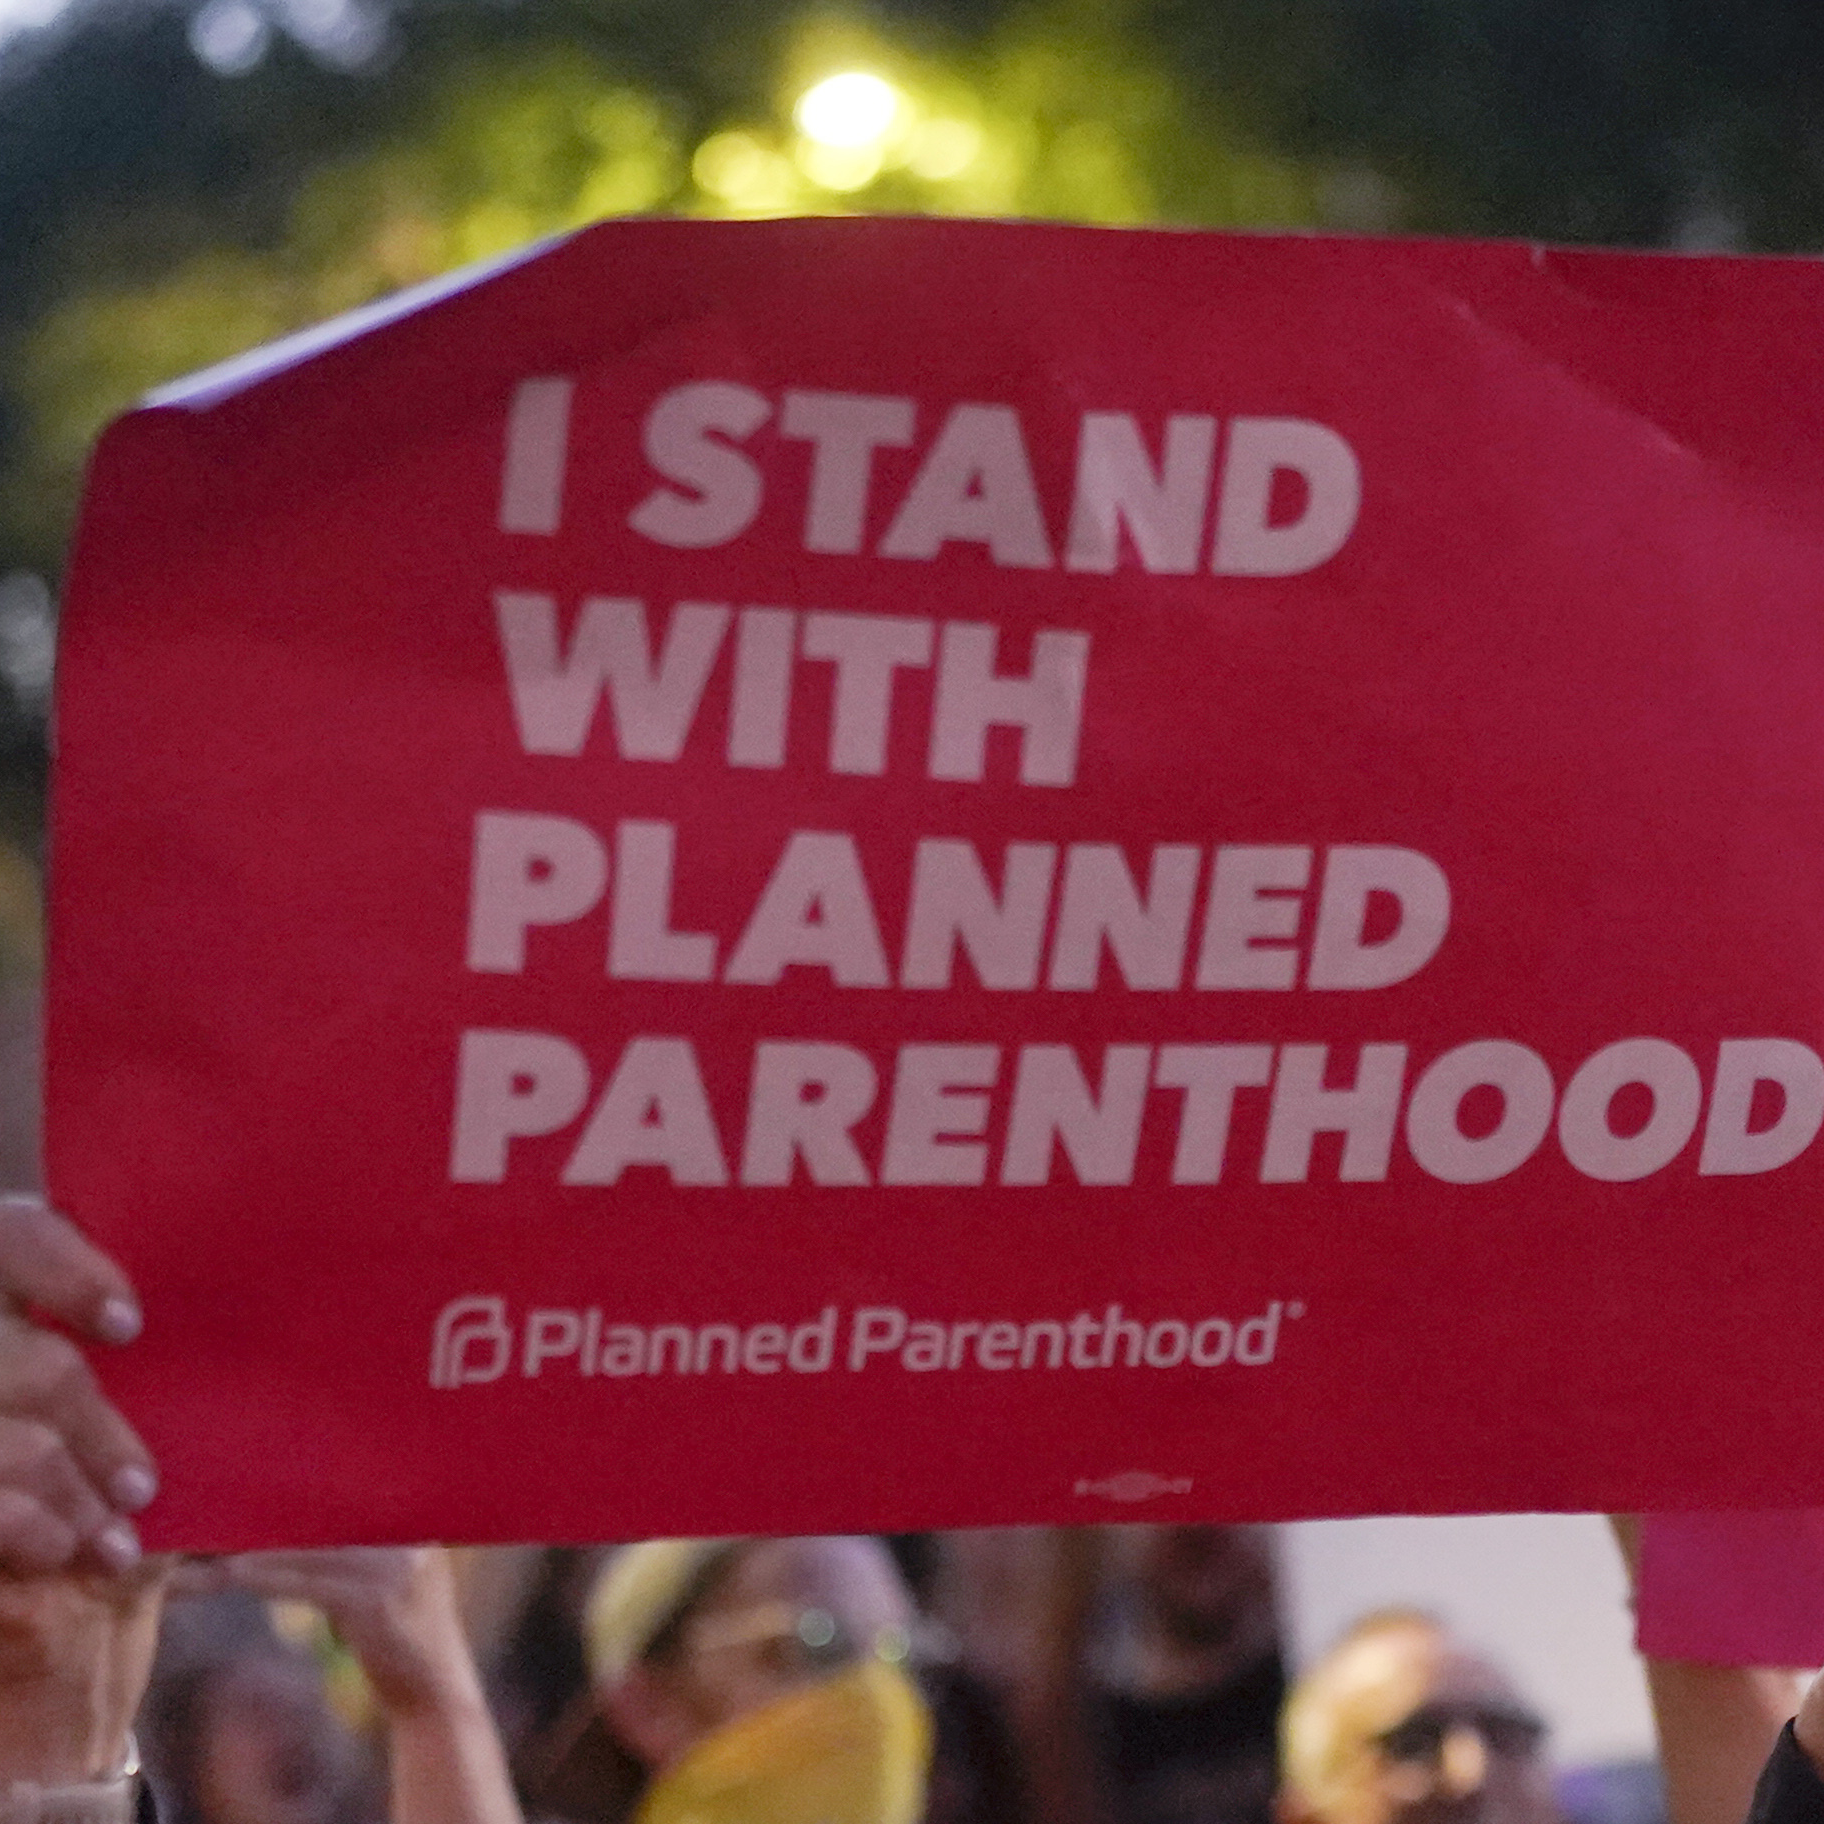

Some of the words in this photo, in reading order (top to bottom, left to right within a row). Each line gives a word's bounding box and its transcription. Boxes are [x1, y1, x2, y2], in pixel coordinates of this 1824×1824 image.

[497, 377, 574, 536] I
[629, 381, 1362, 577] STAND
[494, 592, 1090, 787] WITH
[465, 809, 1452, 991] PLANNED
[522, 1306, 839, 1378] Planned
[847, 1300, 1284, 1372] Parenthood
